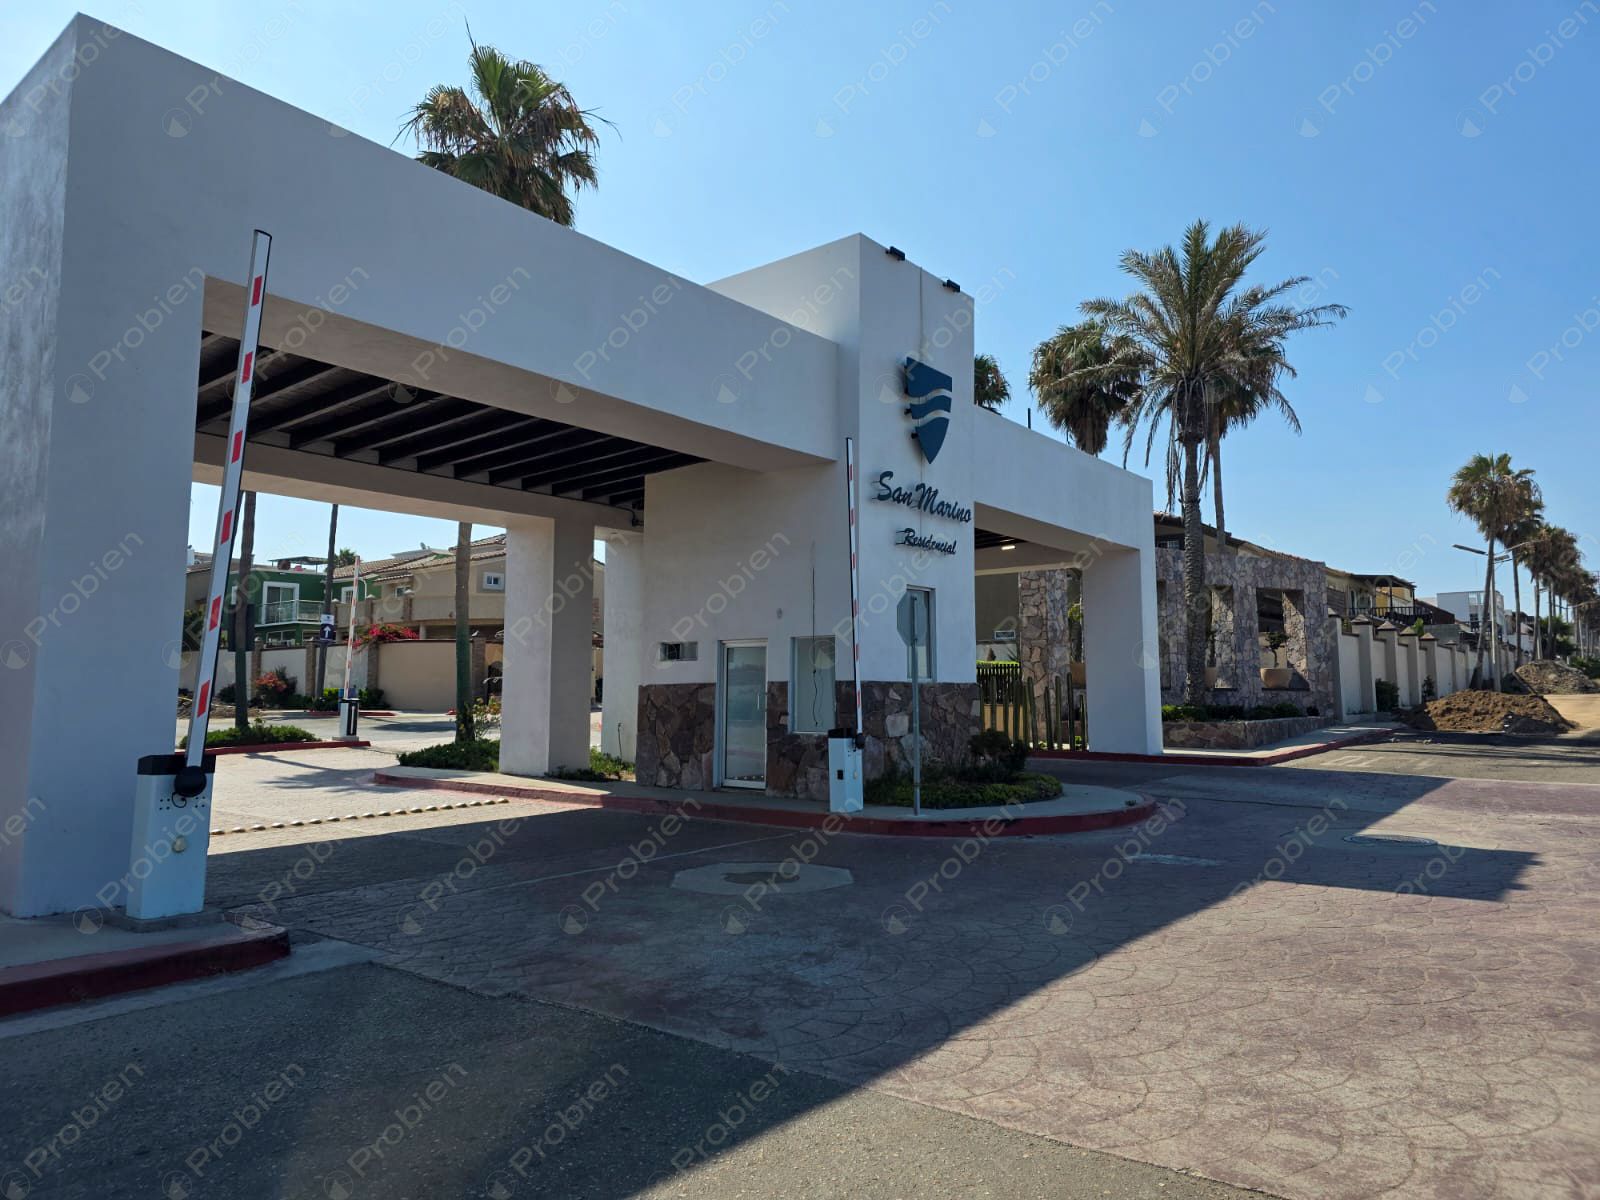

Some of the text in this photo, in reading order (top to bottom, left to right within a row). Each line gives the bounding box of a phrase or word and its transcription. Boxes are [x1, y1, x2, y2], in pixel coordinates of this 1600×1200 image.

[877, 470, 972, 523] San Marino
[902, 527, 957, 555] Residencial
